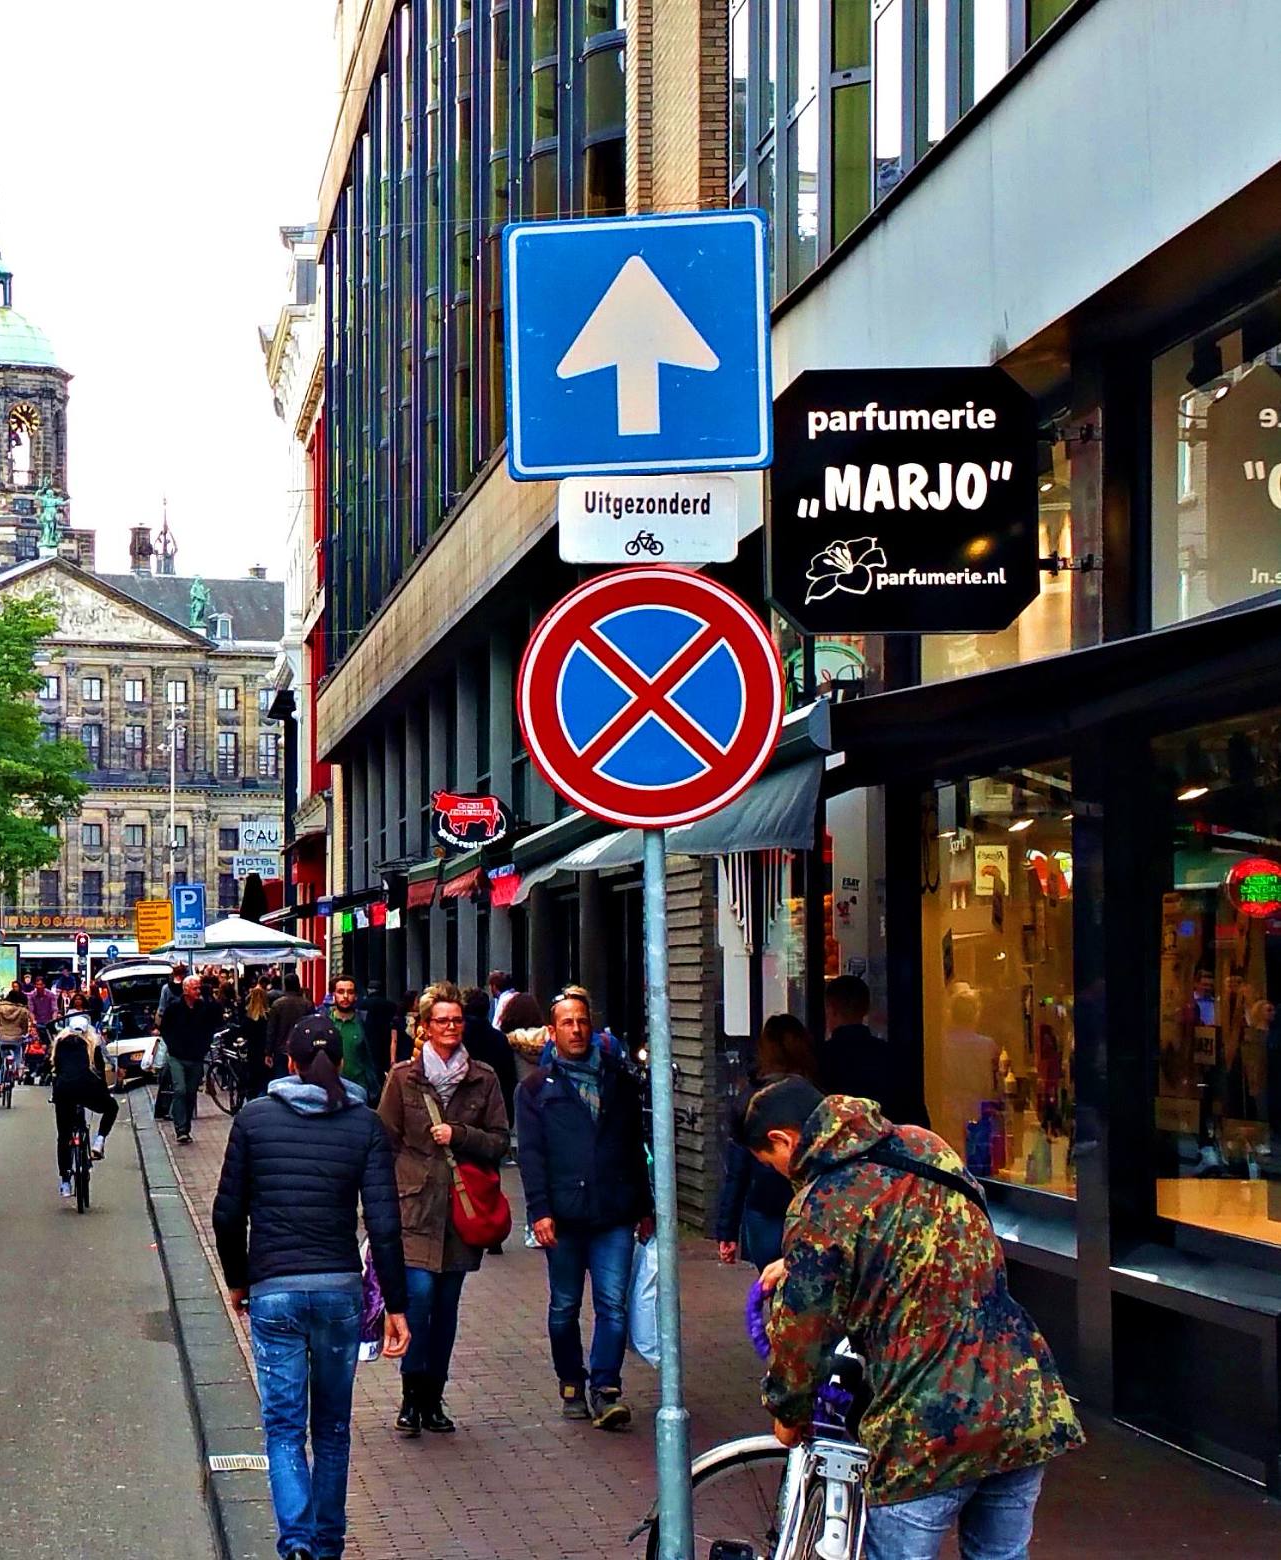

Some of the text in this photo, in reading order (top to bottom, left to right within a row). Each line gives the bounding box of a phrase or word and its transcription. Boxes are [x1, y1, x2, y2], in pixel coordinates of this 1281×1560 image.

[808, 402, 997, 440] parfumerie
[585, 491, 711, 520] Uitgezonderd
[876, 567, 1007, 590] parfumerie.nl
[244, 829, 278, 843] CAU
[236, 858, 276, 866] HOTEL
[180, 890, 197, 913] P
